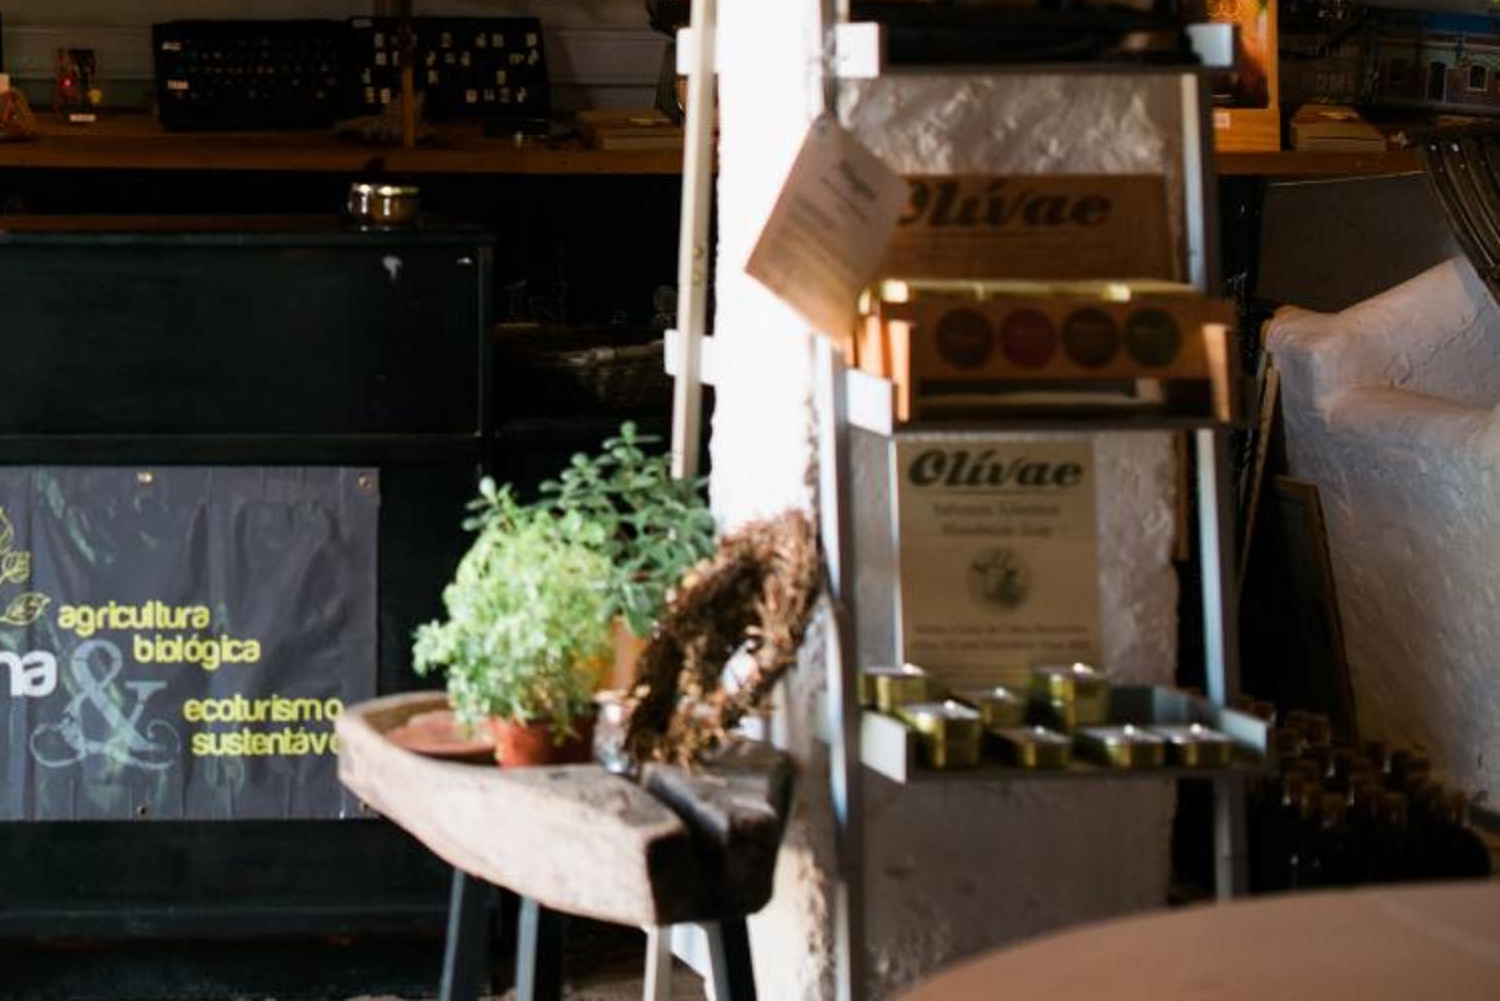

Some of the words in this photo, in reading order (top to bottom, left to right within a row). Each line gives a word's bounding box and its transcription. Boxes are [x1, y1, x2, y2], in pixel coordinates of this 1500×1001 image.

[908, 449, 1083, 487] Olívae
[57, 600, 211, 638] agricultura
[132, 633, 261, 671] biológica
[183, 693, 344, 722] ecoturismo
[191, 727, 343, 757] sustentáve
